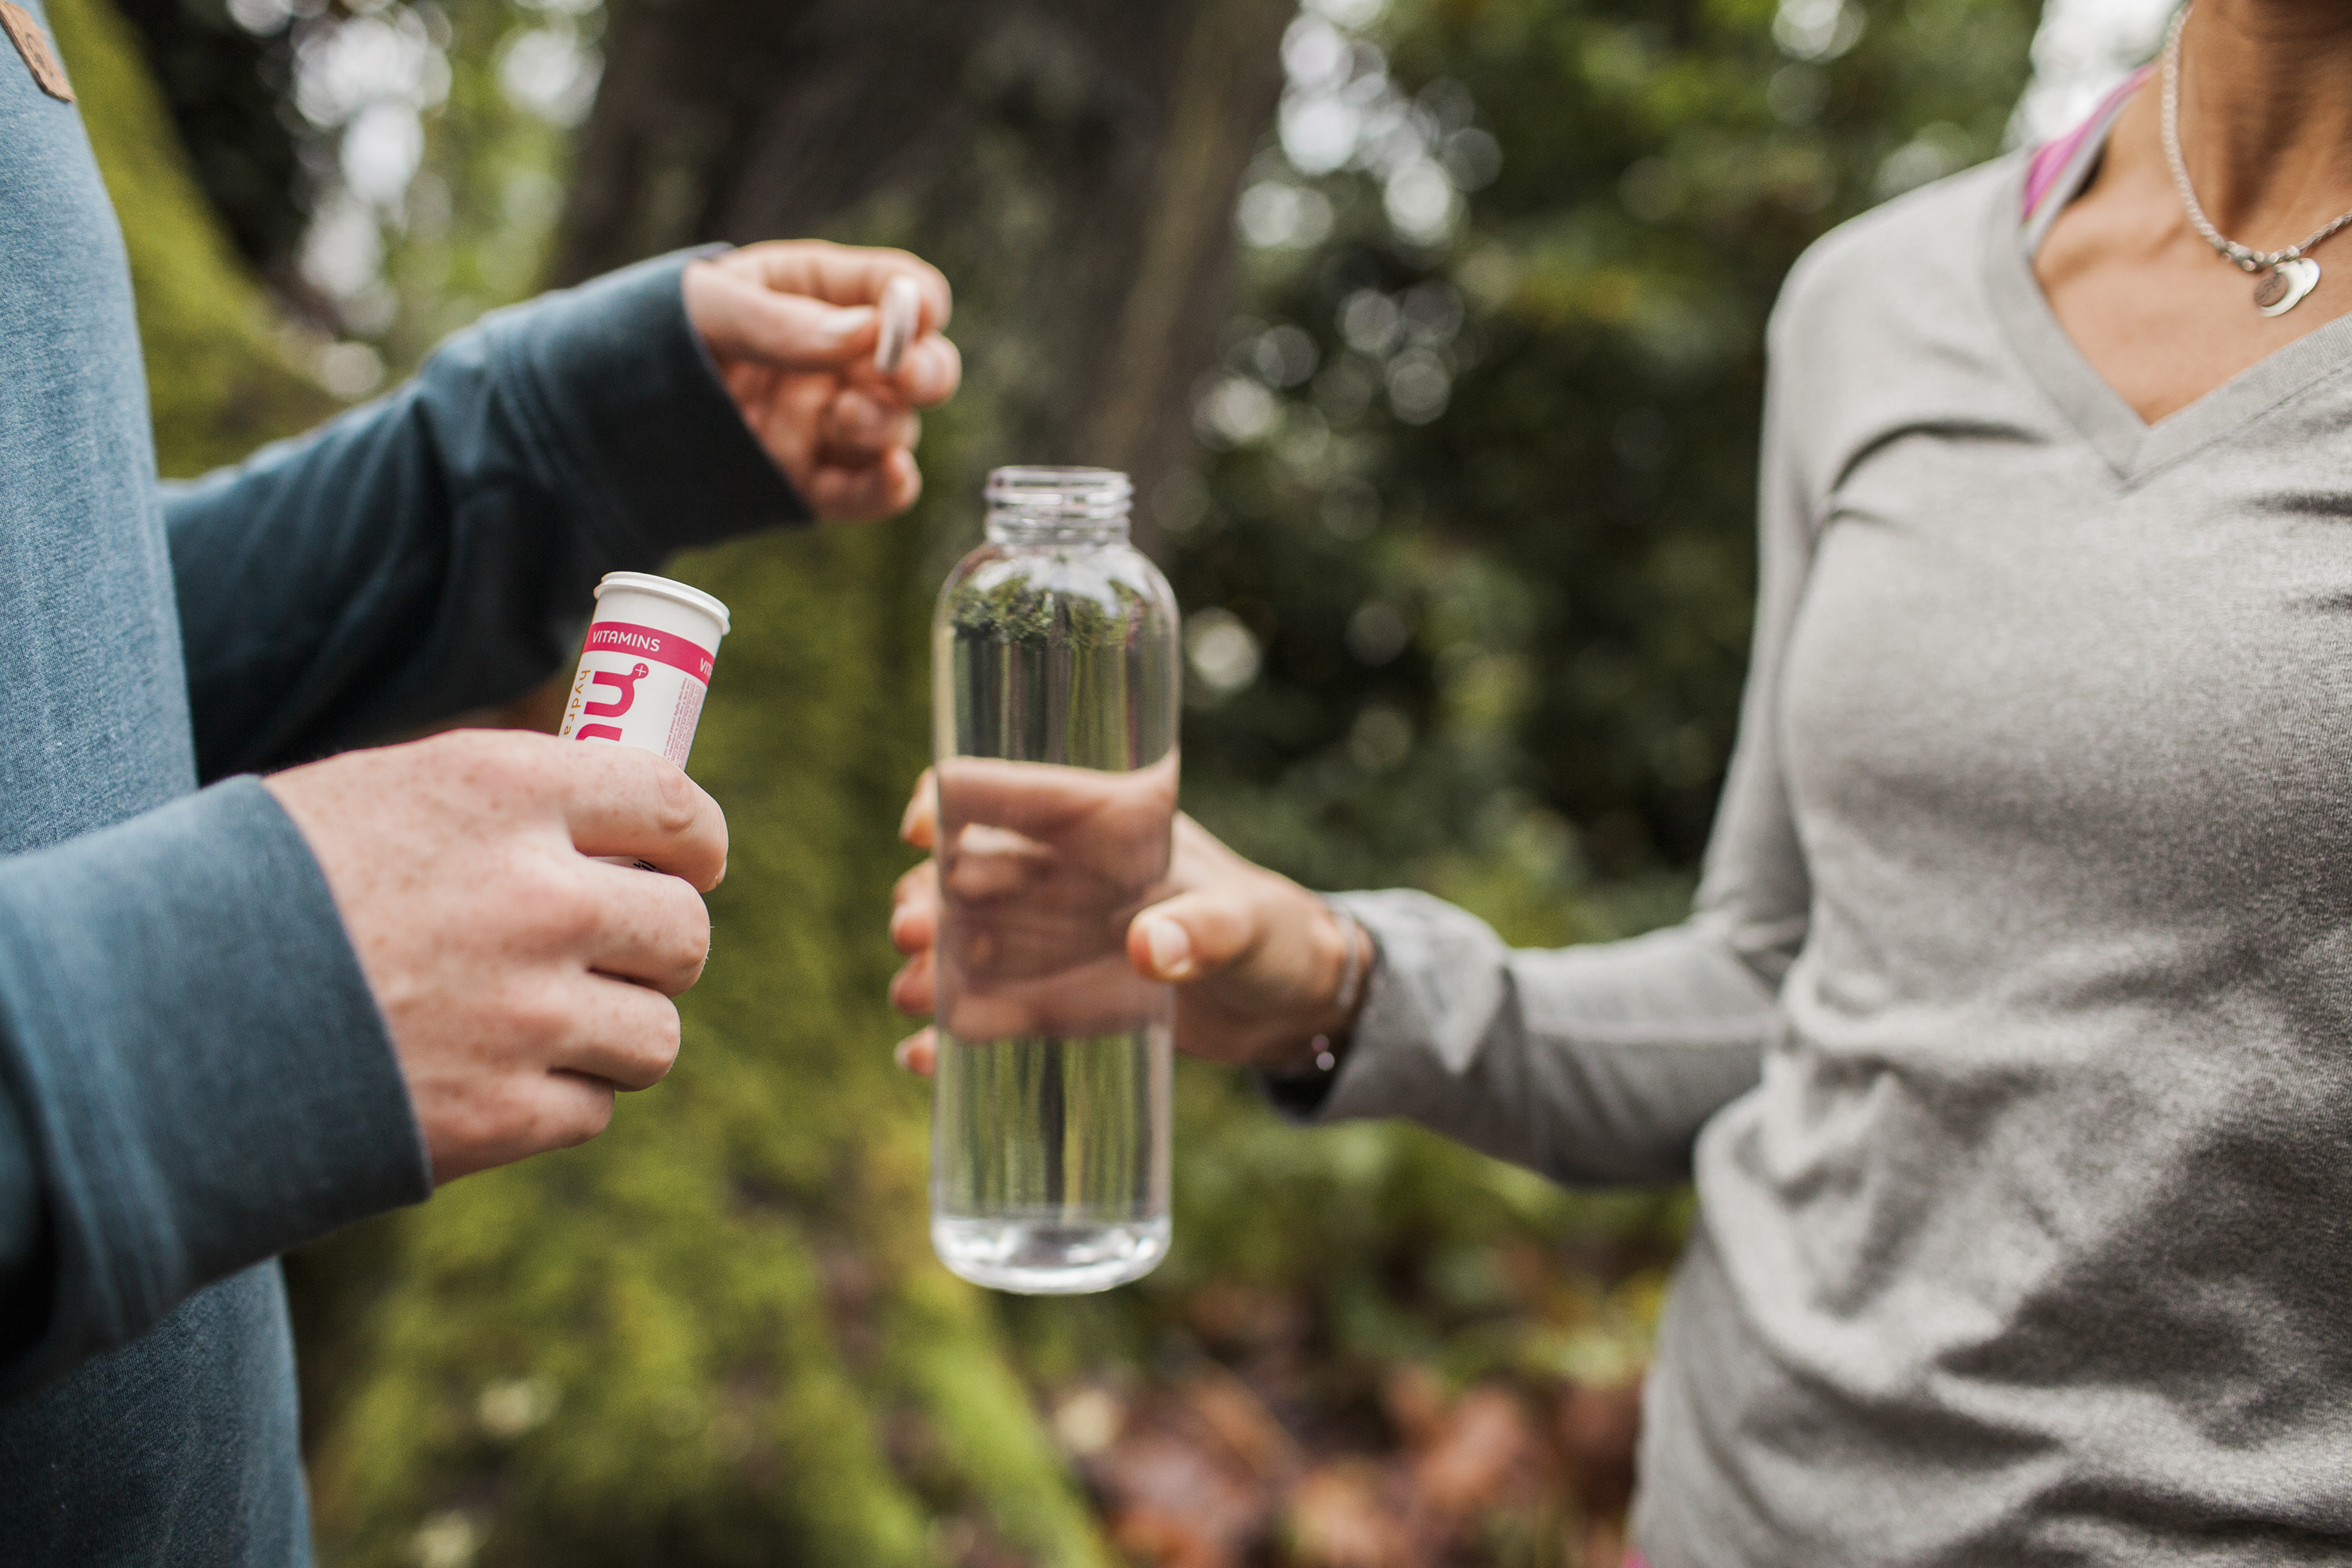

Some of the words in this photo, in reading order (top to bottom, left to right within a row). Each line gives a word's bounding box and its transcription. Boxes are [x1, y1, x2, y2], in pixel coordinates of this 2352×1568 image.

[593, 630, 660, 652] VITAMINS
[700, 657, 713, 676] VIT
[564, 670, 590, 735] hydra
[668, 731, 677, 756] unbroken,
